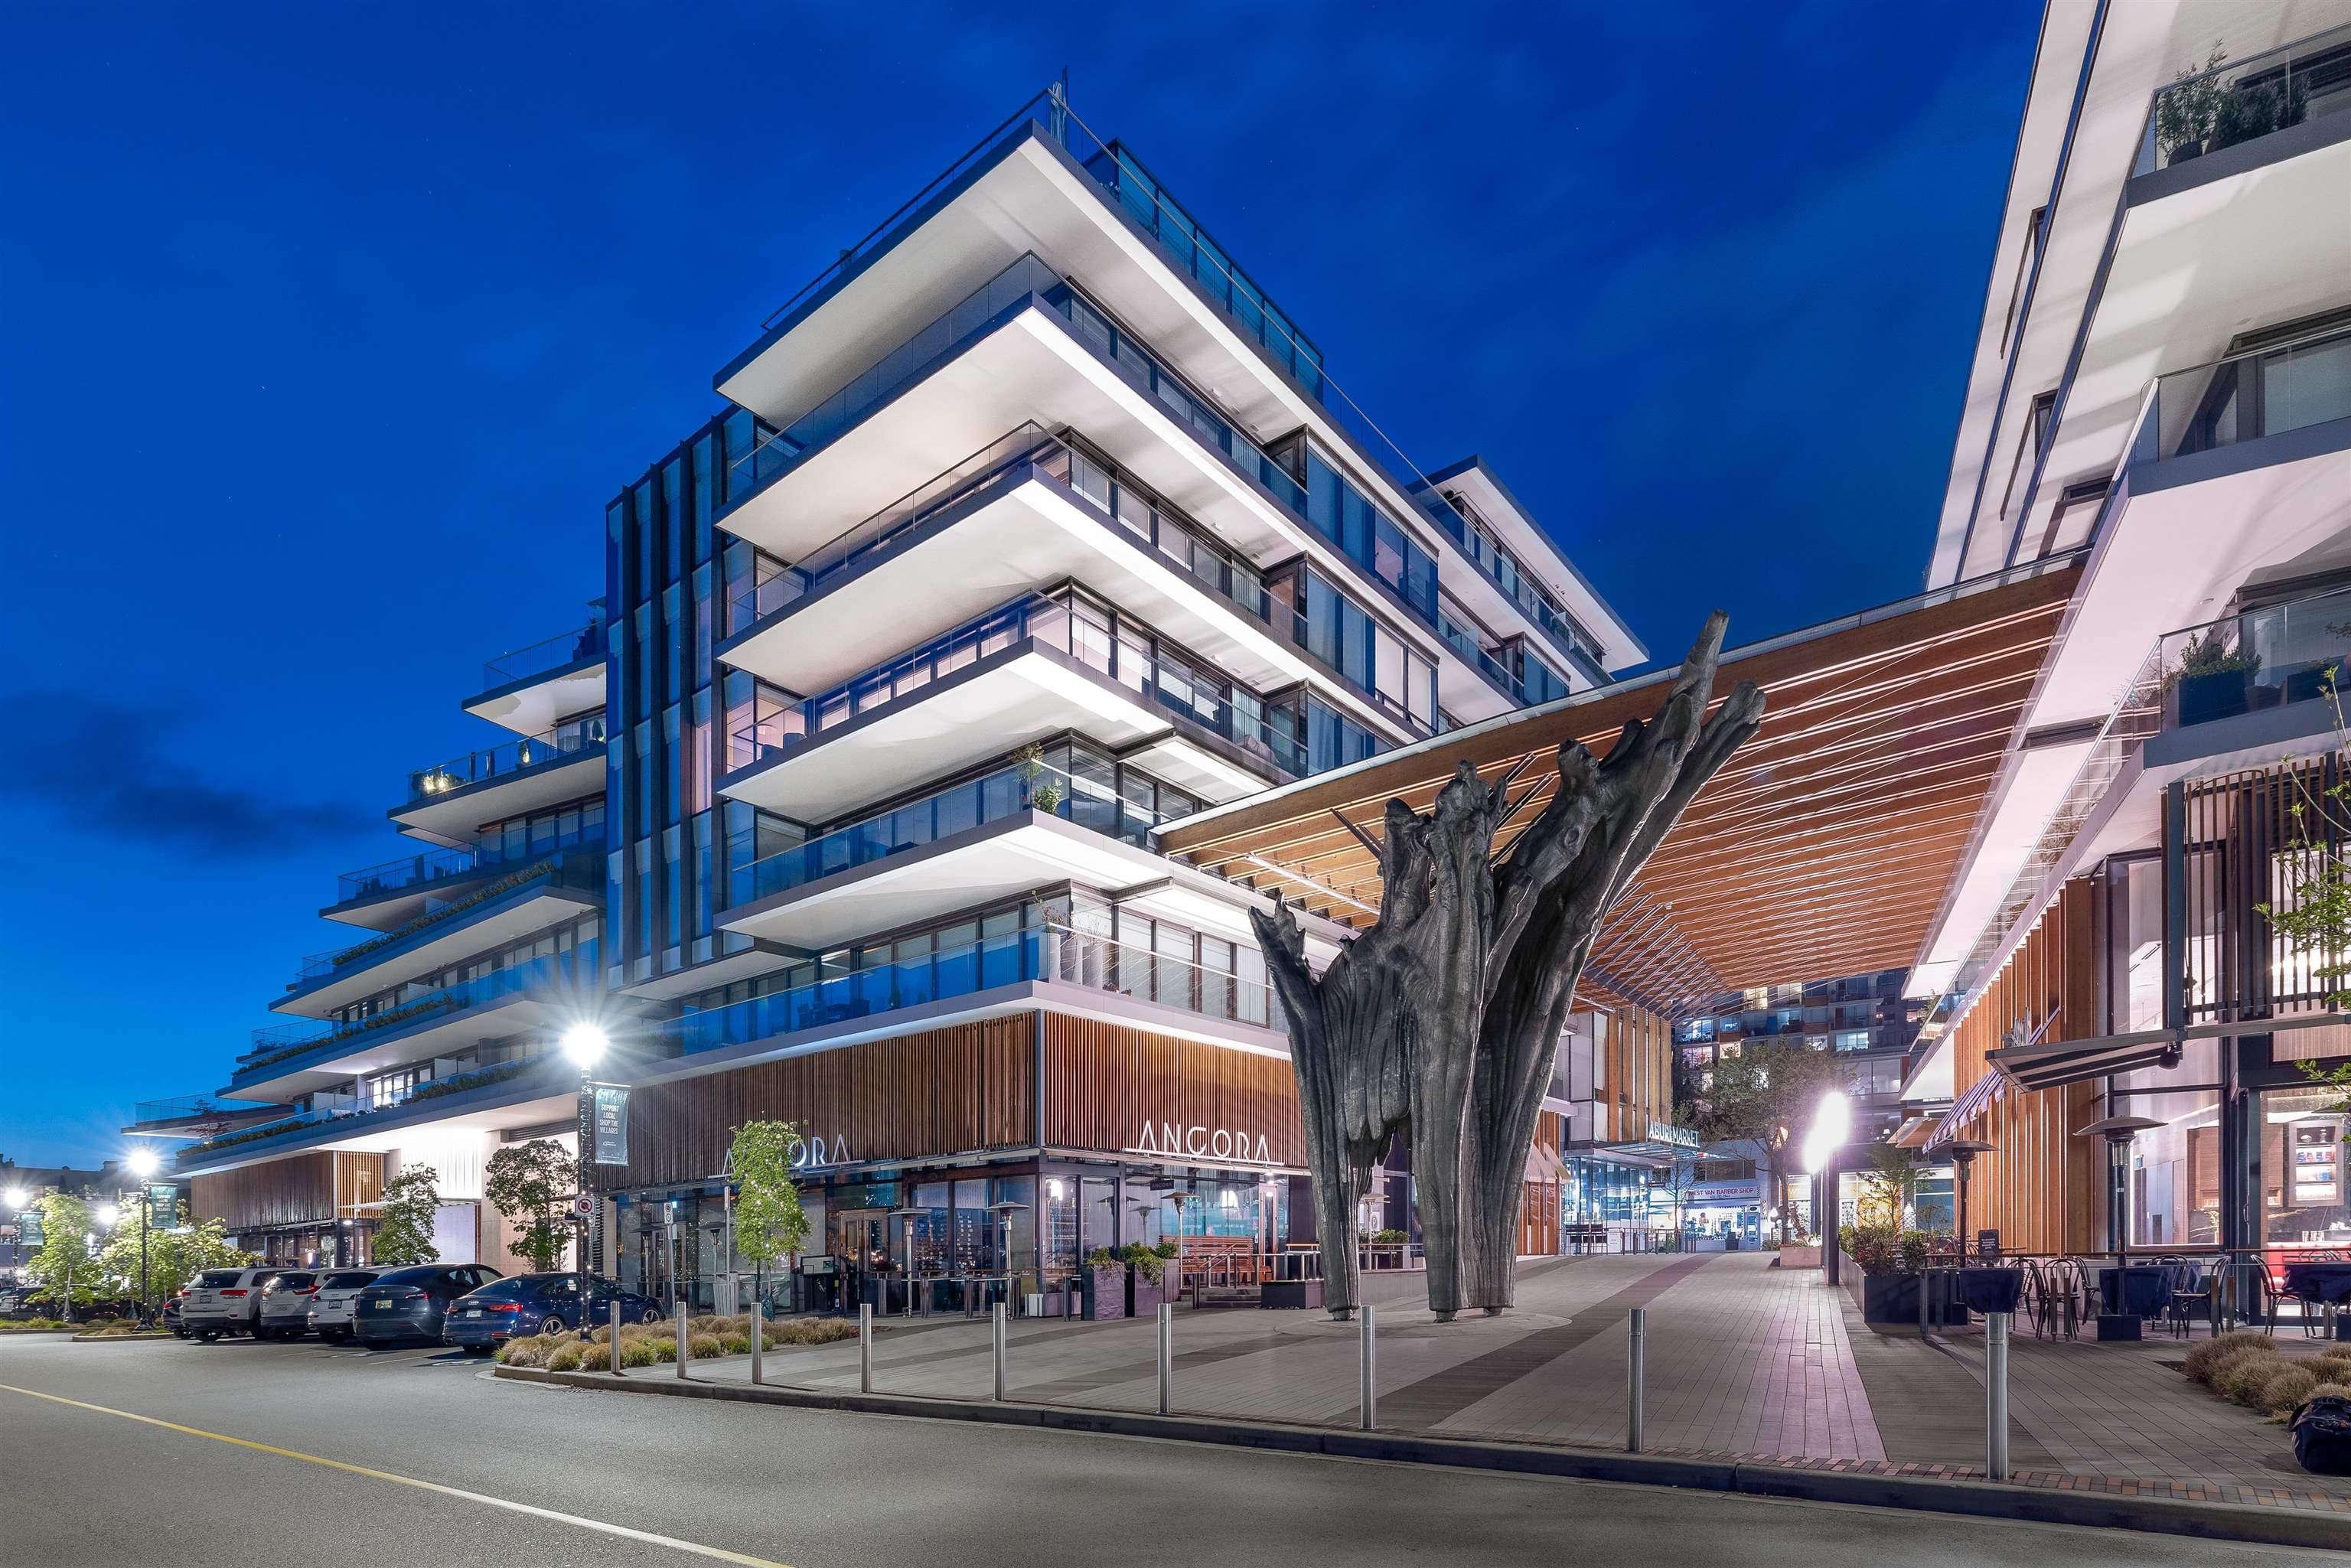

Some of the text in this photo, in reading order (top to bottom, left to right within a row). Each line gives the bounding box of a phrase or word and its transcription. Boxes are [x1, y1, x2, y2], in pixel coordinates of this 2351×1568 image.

[1649, 1120, 1700, 1146] ABURI MARKET
[722, 1133, 849, 1175] AORA
